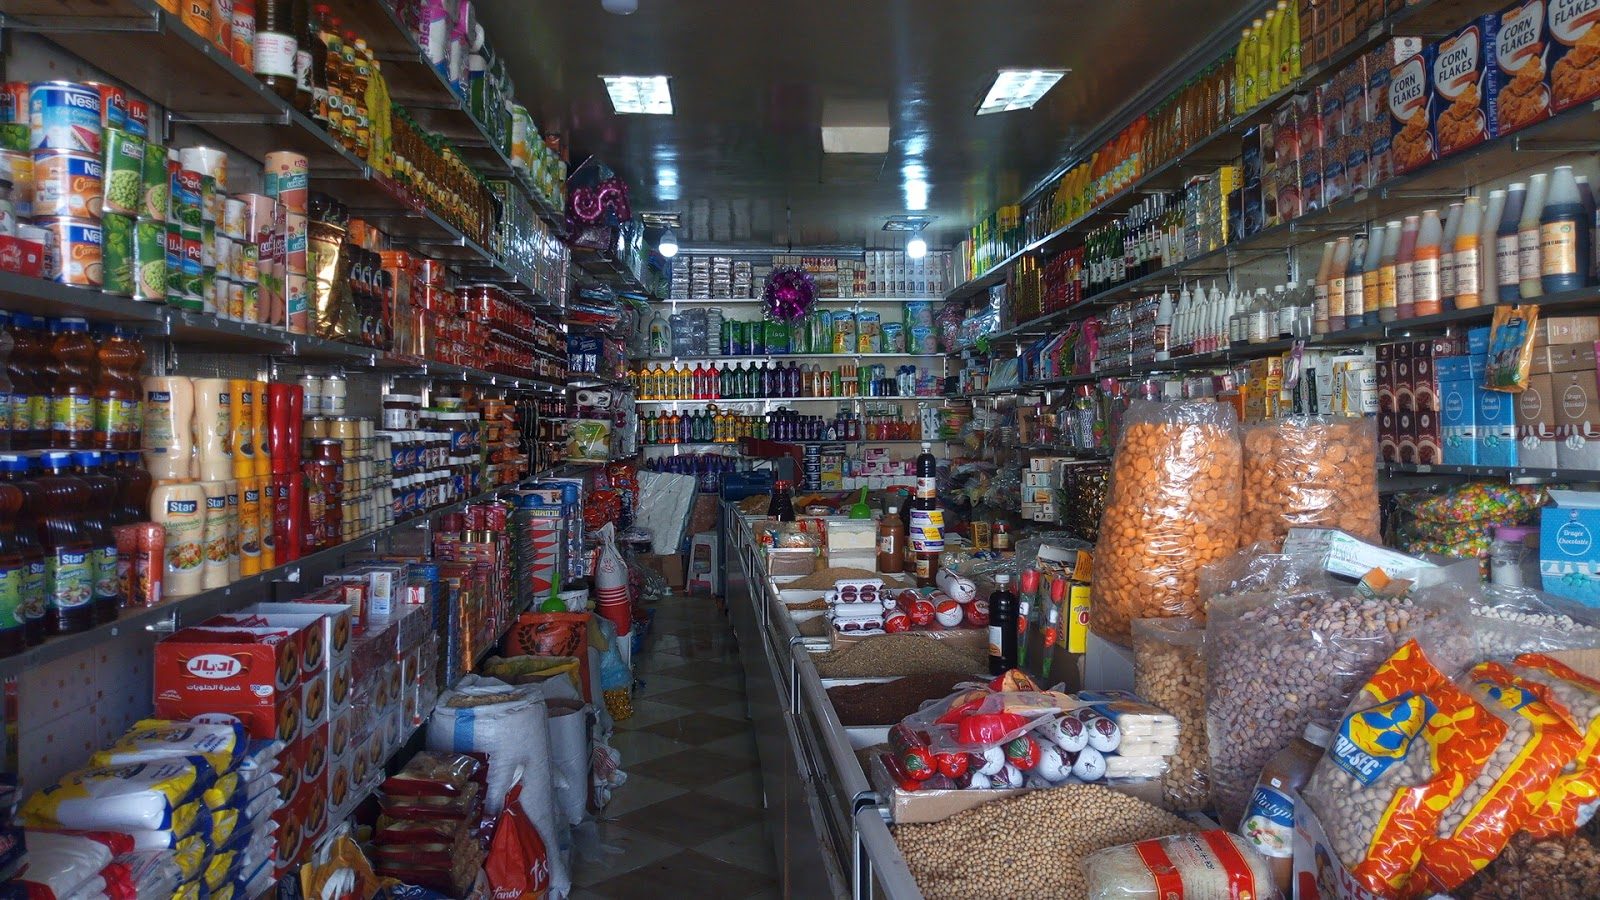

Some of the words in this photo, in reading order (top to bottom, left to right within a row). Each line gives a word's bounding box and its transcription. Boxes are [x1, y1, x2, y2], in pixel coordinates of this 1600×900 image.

[1504, 16, 1533, 41] CORN
[1500, 28, 1535, 56] FLAKES
[1441, 46, 1468, 69] CORN
[1439, 58, 1472, 83] FLAKES
[1394, 73, 1416, 93] CORN
[1393, 84, 1421, 107] FLAKES
[169, 501, 196, 512] Star
[207, 497, 225, 508] Star
[62, 554, 84, 563] Star
[186, 683, 218, 692] الحلويات
